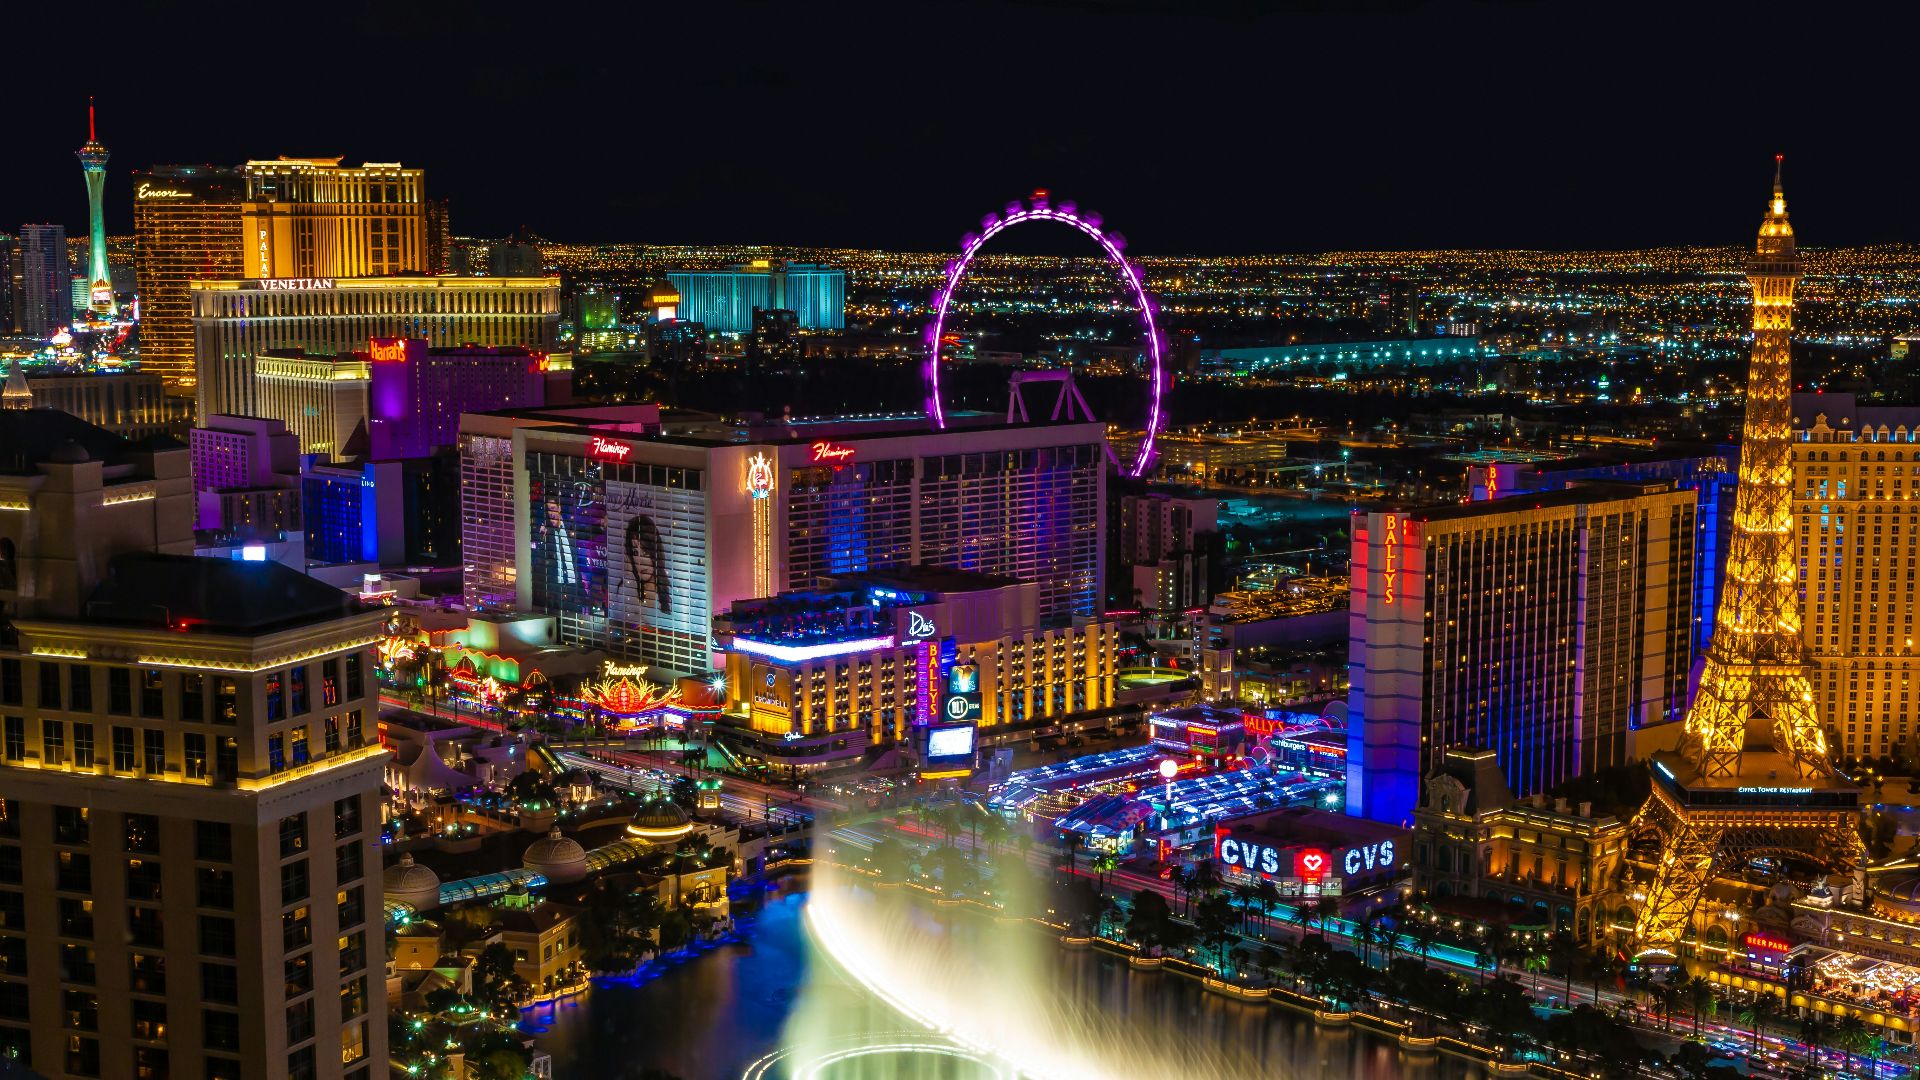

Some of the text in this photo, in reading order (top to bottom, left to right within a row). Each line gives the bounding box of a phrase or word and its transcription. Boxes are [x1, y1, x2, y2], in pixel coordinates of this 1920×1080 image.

[138, 183, 192, 199] Encore
[259, 279, 333, 290] VENETIAN
[593, 437, 630, 460] Flamingo
[812, 442, 855, 461] Flamingo
[1384, 515, 1398, 604] BALLYS
[604, 660, 649, 681] Flamingo
[928, 644, 938, 715] BALLYS
[1244, 714, 1285, 734] BALLY'S
[1220, 838, 1279, 874] CVS
[1344, 840, 1394, 875] CVS
[1747, 936, 1789, 952] BEER PARK
